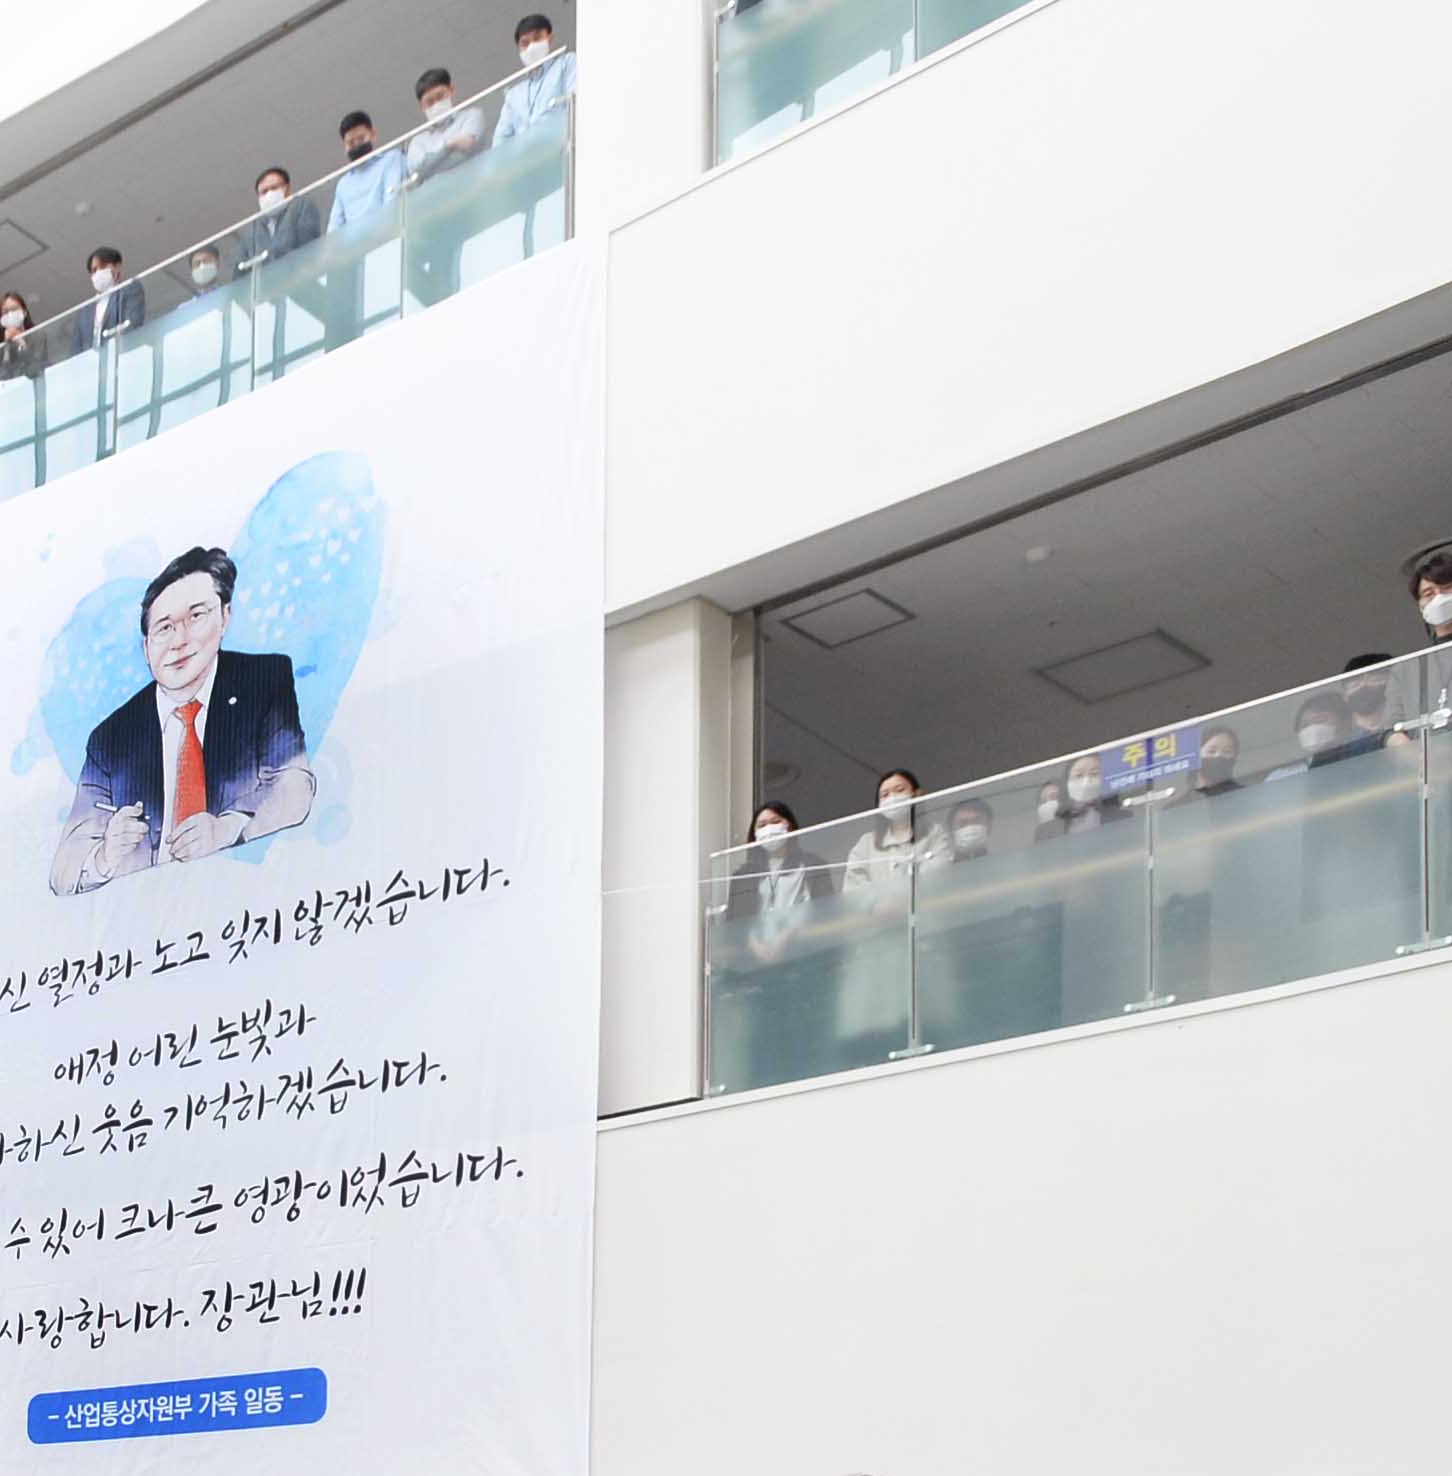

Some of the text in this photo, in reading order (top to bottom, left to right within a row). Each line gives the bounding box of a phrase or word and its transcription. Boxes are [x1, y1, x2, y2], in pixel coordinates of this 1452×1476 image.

[37, 949, 141, 1008] 열정과
[151, 931, 210, 975] 노고
[221, 908, 281, 964] 잊지
[293, 858, 510, 946] 않겠습니다.
[54, 999, 316, 1086] 애정 어린 눈빛과
[92, 1099, 153, 1154] 웃음
[163, 1052, 447, 1131] 기억하겠습니다.
[40, 1207, 105, 1259] 있어
[233, 1146, 523, 1224] 영광이었습니다.
[200, 1267, 366, 1333] 장관님!!!
[64, 1394, 193, 1429] 산업통상자원부
[199, 1390, 238, 1418] 가족
[244, 1386, 284, 1415] 일동
